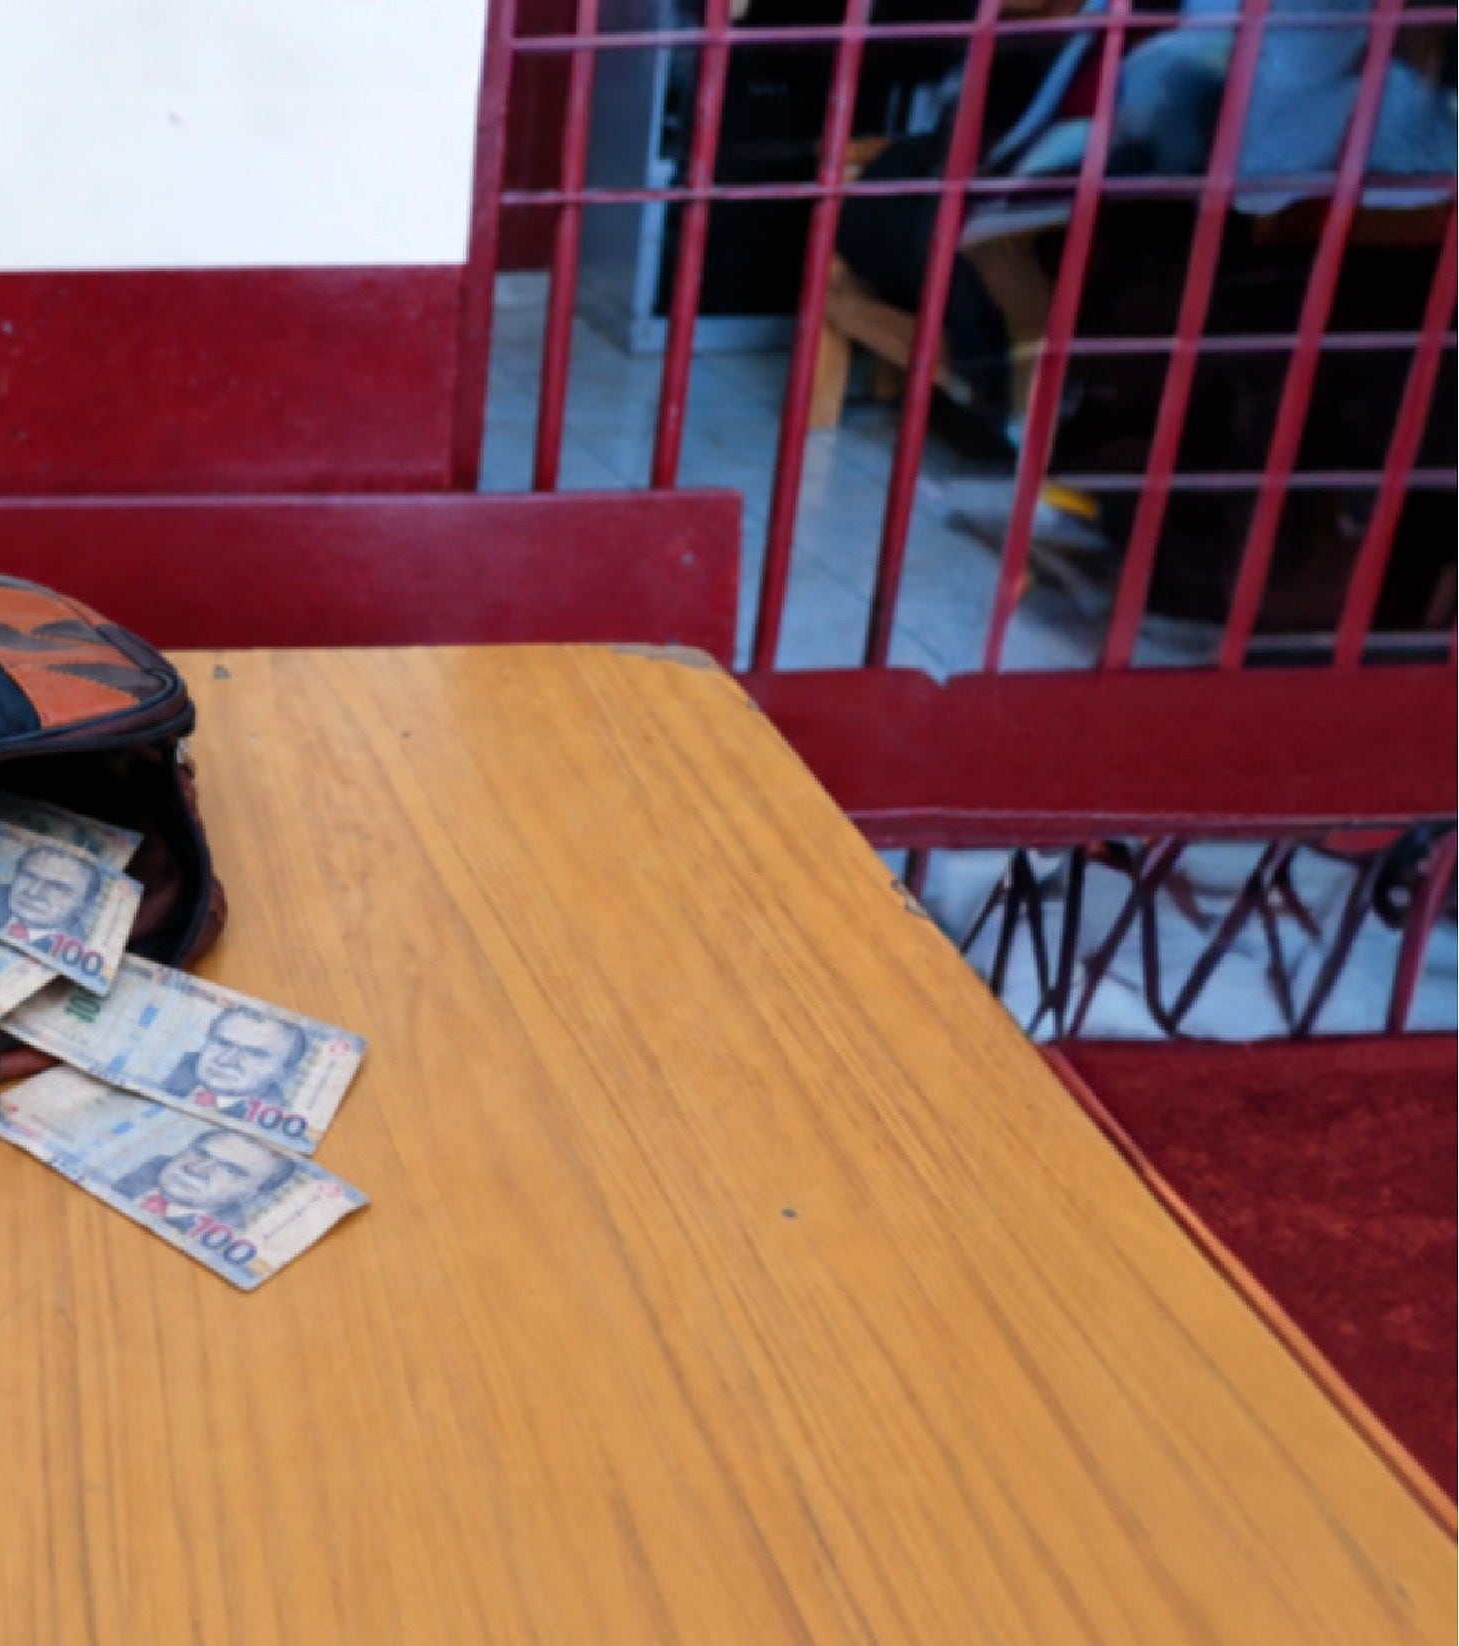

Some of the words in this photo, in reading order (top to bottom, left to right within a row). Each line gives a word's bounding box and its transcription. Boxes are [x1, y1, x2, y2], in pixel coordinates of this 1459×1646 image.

[50, 931, 104, 976] 100
[246, 1098, 309, 1137] 100
[190, 1215, 257, 1264] 100
